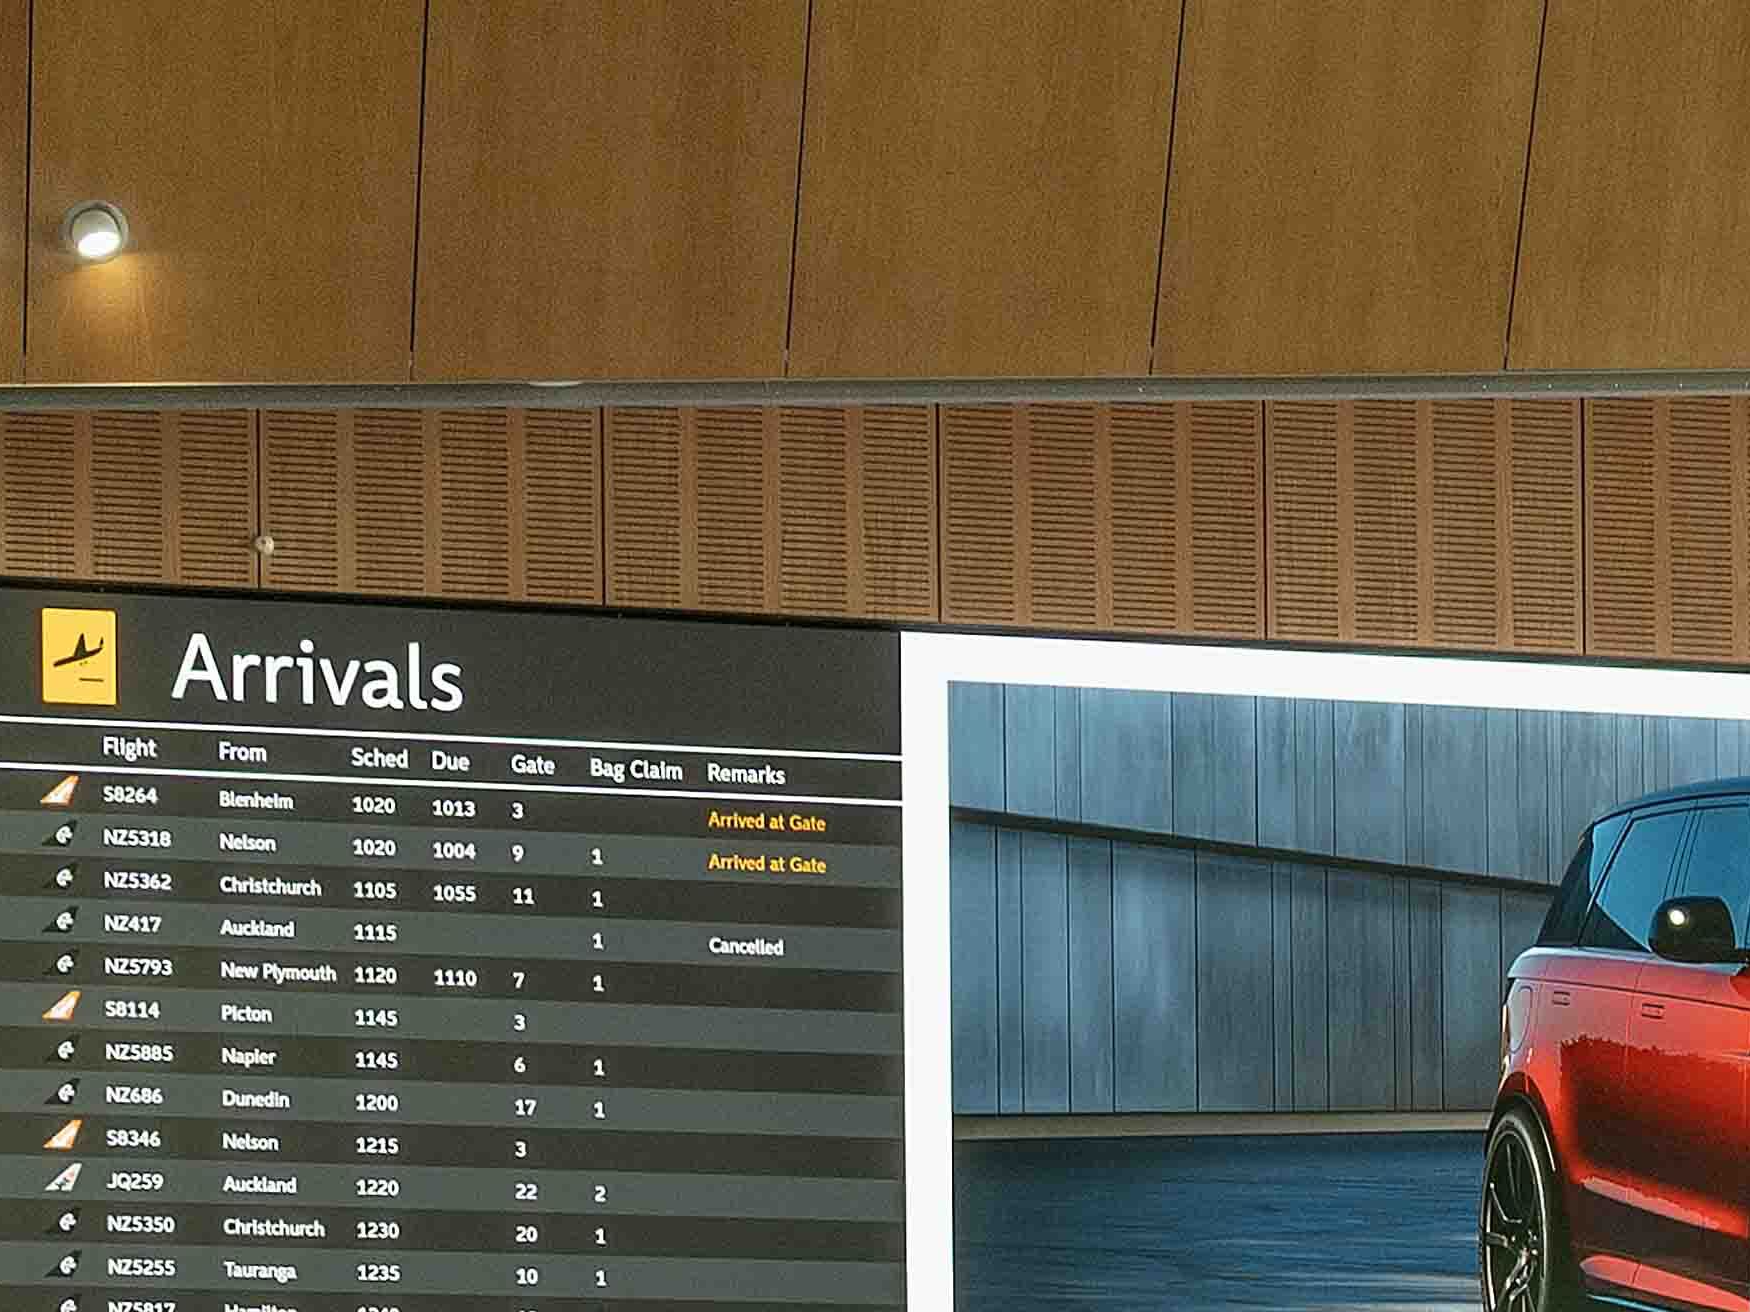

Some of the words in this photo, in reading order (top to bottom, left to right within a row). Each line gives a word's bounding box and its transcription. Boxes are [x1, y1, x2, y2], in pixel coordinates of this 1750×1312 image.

[171, 633, 463, 712] Arrivals
[103, 736, 158, 762] Flight
[219, 741, 267, 763] From
[351, 747, 409, 769] Sched
[432, 750, 470, 772] Due
[511, 754, 556, 775] Gate
[590, 757, 625, 784] Bag
[629, 759, 683, 781] Claim
[707, 762, 786, 785] Remarks
[103, 785, 159, 804] S8264
[219, 790, 294, 810] Blenheim
[352, 796, 396, 814] 1020
[432, 799, 476, 817] 1013
[512, 802, 524, 819] 3
[708, 811, 765, 829] Arrived
[769, 814, 785, 831] at
[789, 814, 827, 832] Gate
[104, 914, 162, 933] NZ417
[220, 919, 295, 938] Auckland
[353, 924, 397, 941] 1115
[592, 932, 604, 949] 1
[708, 937, 784, 956] Cancelled
[104, 957, 173, 976] NZ5793
[220, 961, 253, 981] New
[257, 963, 337, 986] Plymouth
[354, 966, 397, 984] 1120
[433, 969, 478, 987] 1110
[512, 971, 525, 989] 7
[593, 975, 605, 992] 1
